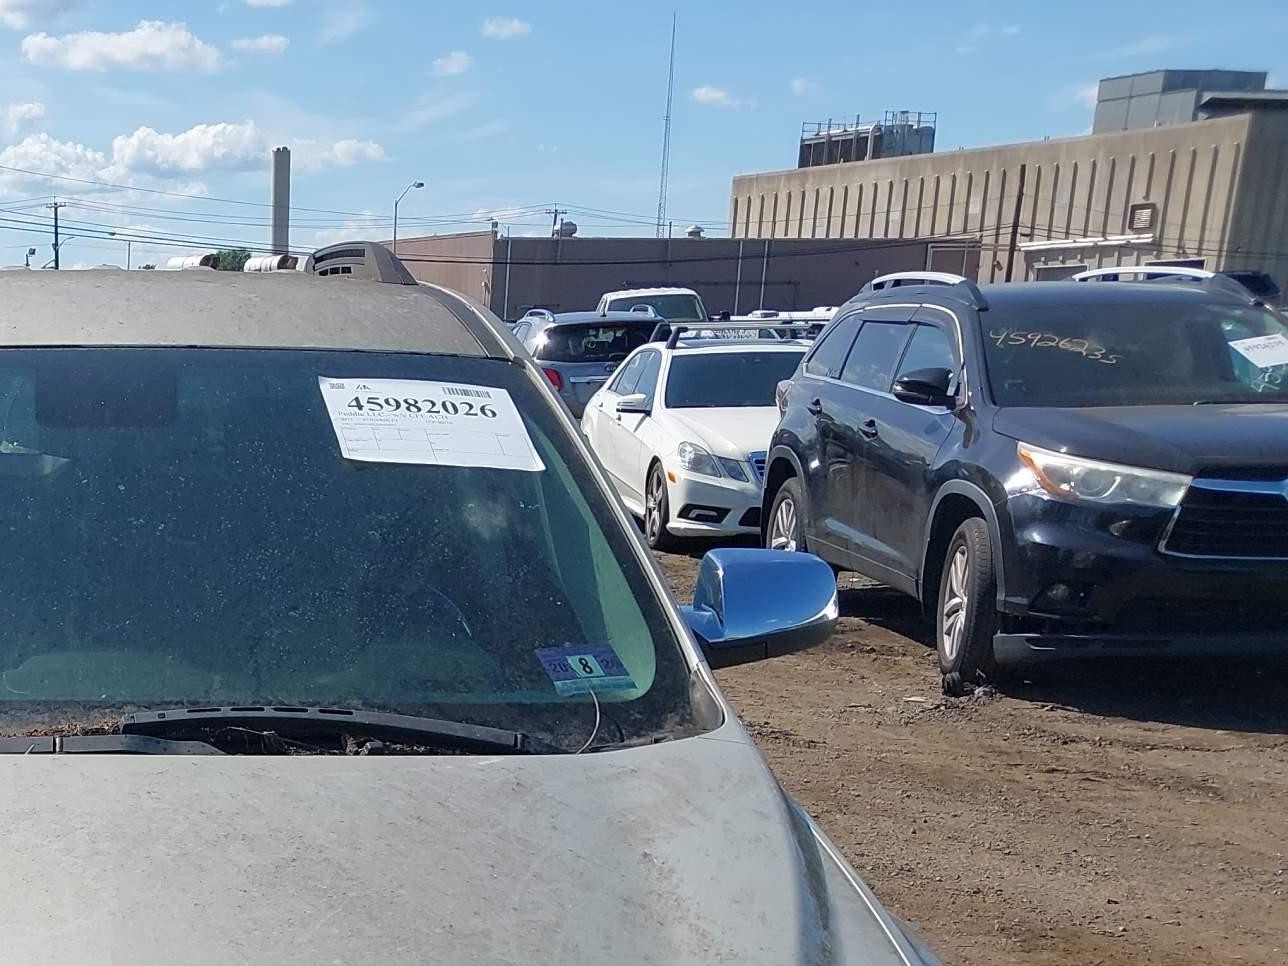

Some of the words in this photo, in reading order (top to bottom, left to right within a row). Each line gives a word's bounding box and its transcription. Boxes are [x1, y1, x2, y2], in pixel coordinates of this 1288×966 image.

[989, 328, 1125, 365] 45926235
[346, 395, 498, 419] 45982026
[578, 657, 594, 675] 8
